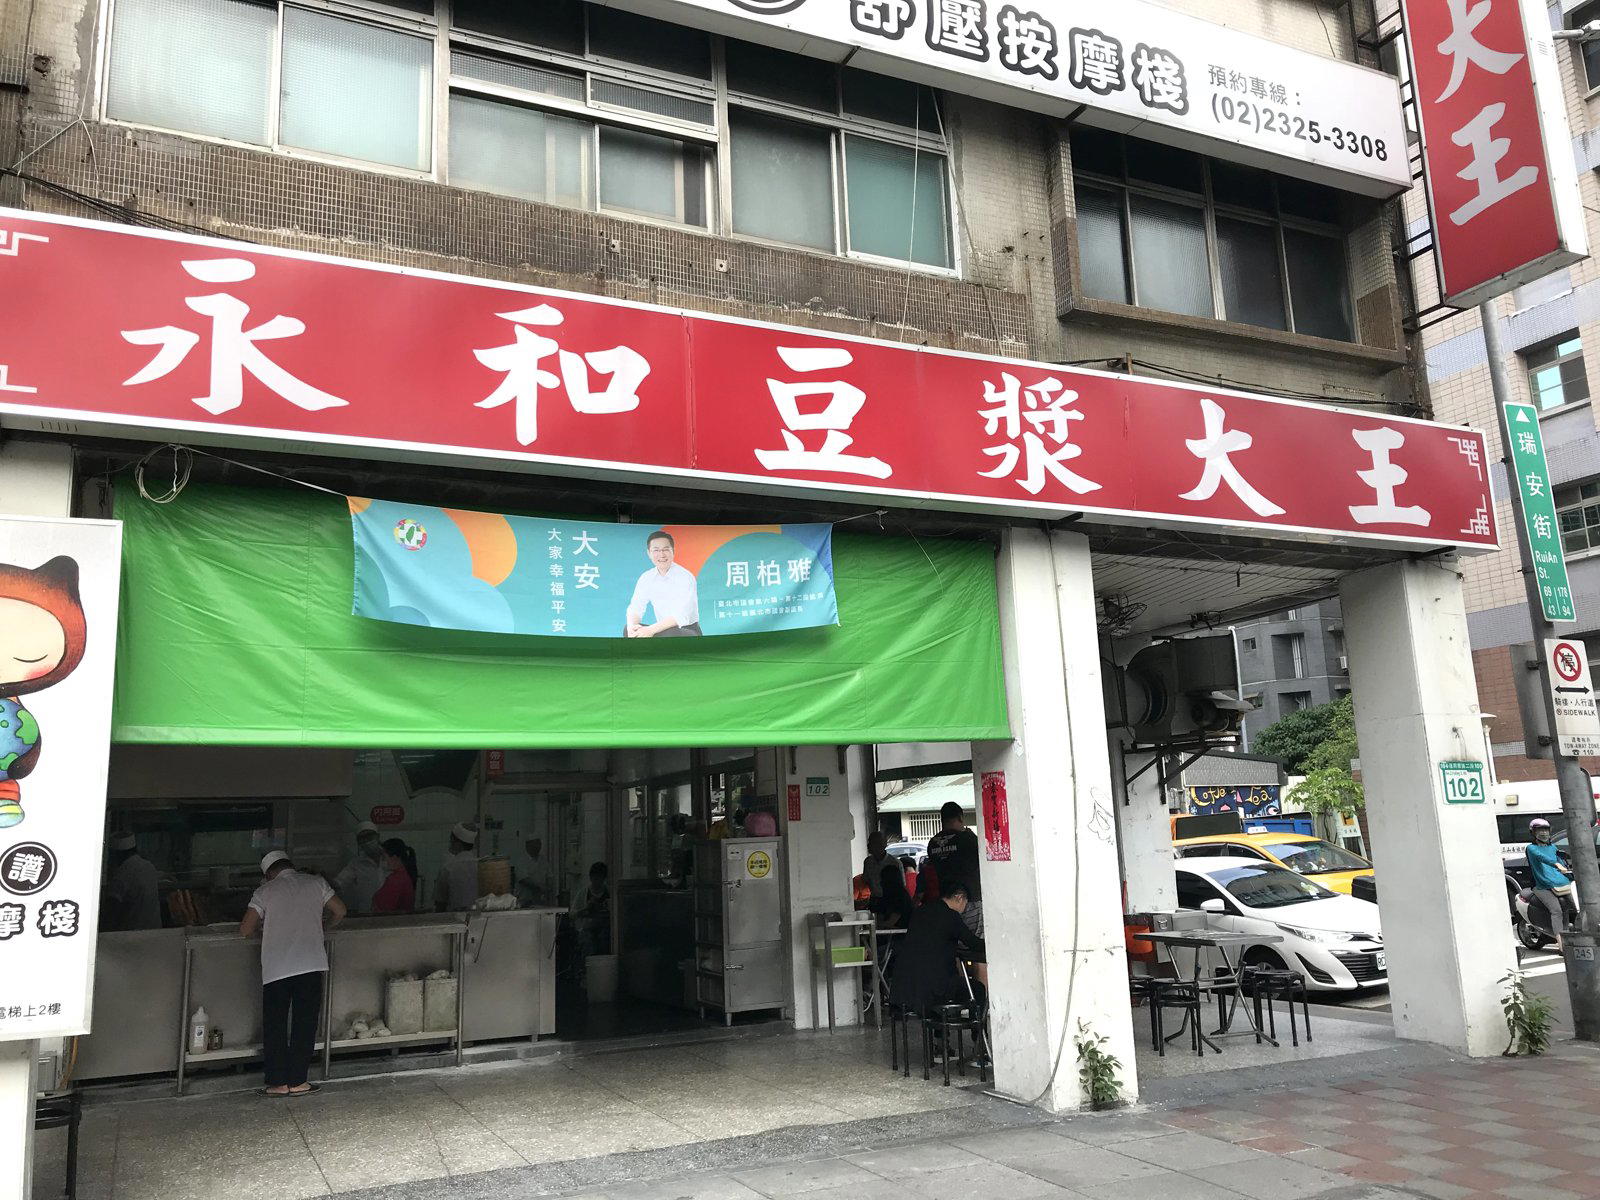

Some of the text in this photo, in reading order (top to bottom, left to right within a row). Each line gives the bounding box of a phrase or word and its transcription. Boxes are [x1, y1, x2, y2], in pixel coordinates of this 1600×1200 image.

[1211, 93, 1389, 162] (02)2325-3308
[1435, 0, 1540, 226] 大王
[120, 257, 1432, 528] 永和豆漿大王
[1517, 431, 1552, 540] 瑞安街
[572, 530, 601, 590] 大安
[725, 557, 813, 588] 周柏雅
[1534, 550, 1559, 564] RuiAn
[1538, 566, 1551, 580] St.
[547, 527, 568, 634] 大家幸福平安
[1563, 708, 1597, 717] SIDEWALK
[808, 785, 829, 794] 102
[1448, 777, 1480, 797] 102
[7, 852, 46, 885] 讚
